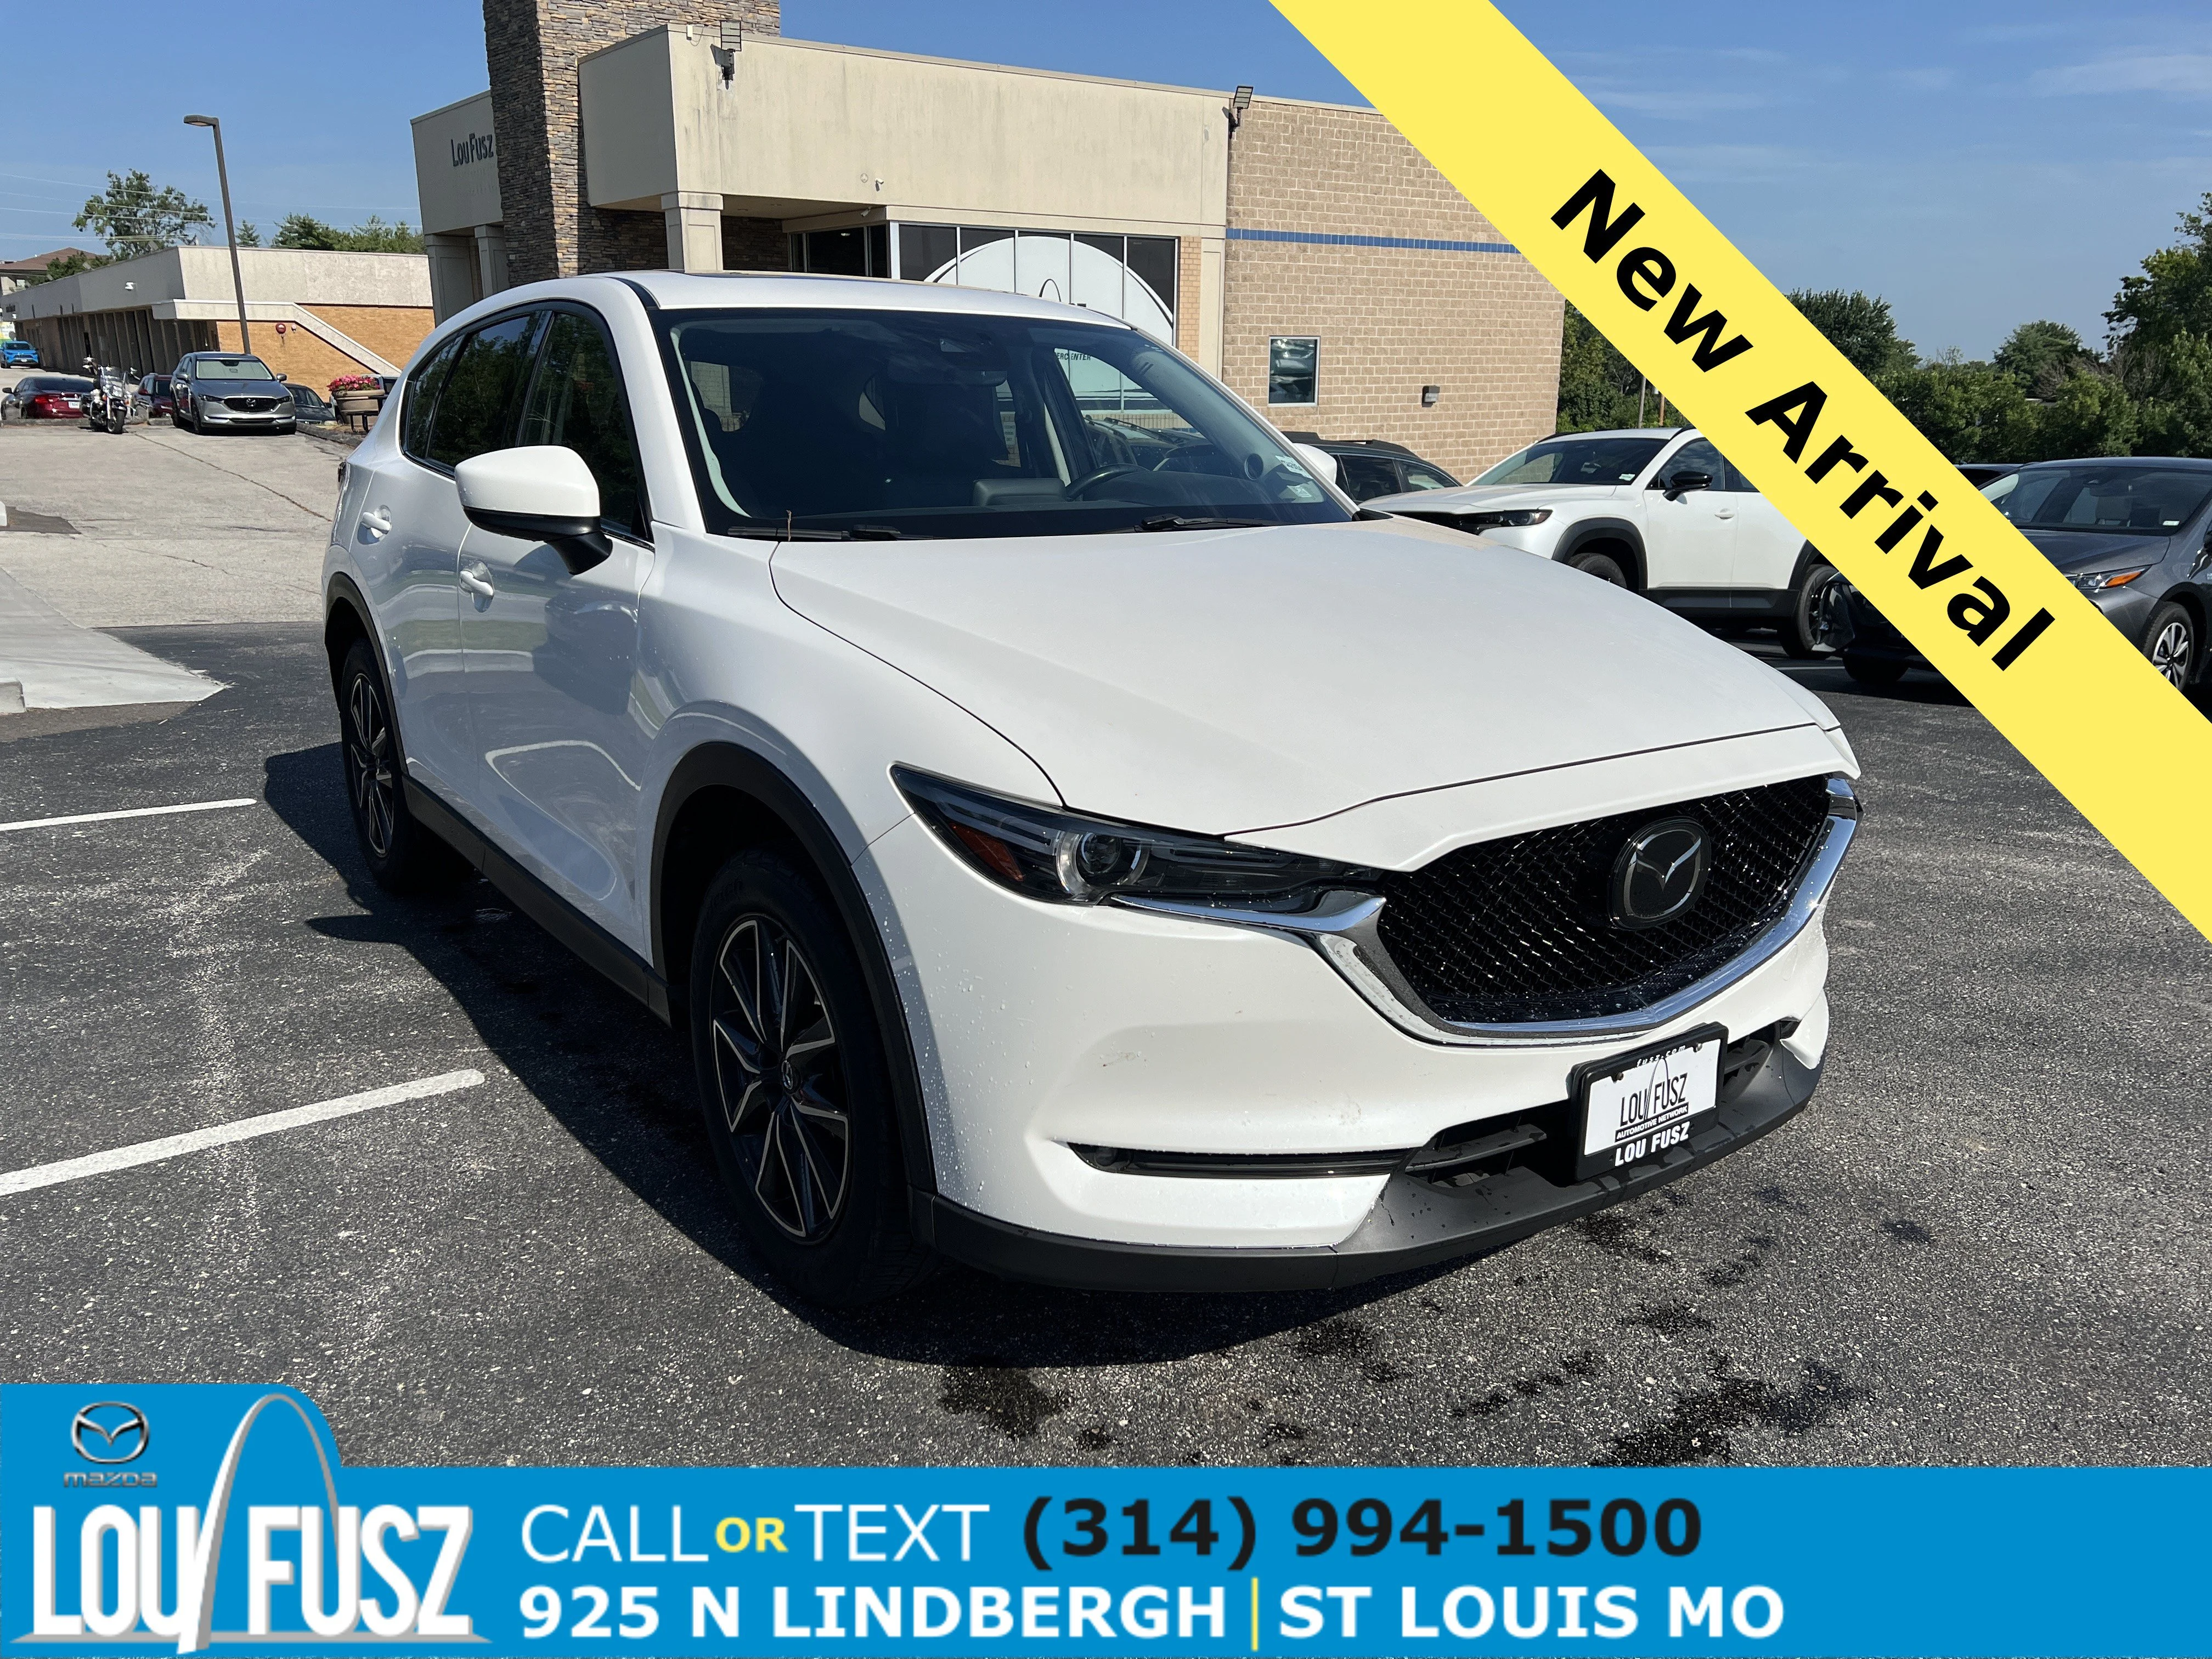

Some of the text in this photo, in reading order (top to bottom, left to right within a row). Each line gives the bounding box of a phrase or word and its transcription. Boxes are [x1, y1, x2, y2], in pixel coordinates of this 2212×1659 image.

[1057, 352, 1091, 360] ERCENTER
[1621, 1073, 1688, 1127] LOU FUSZ
[1616, 1105, 1688, 1139] AUTOMOTIVE NETWORK
[1615, 1121, 1690, 1166] LOU FUSZ
